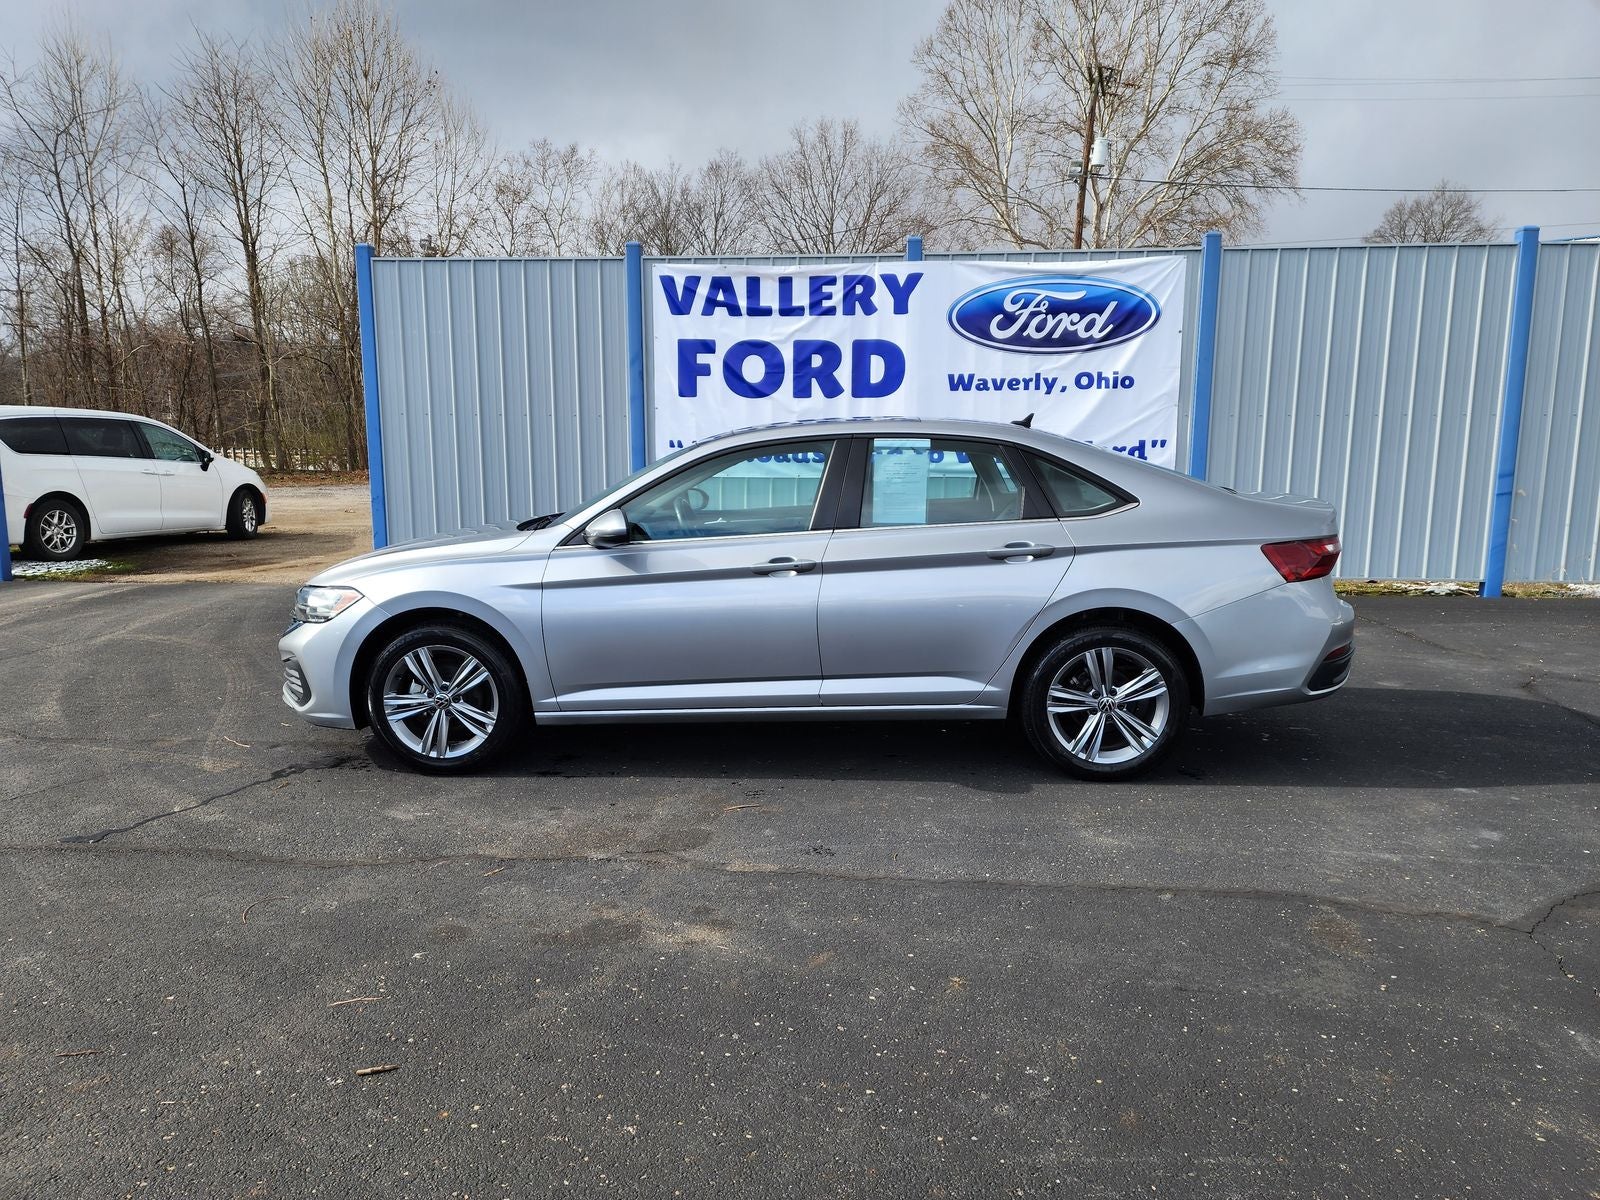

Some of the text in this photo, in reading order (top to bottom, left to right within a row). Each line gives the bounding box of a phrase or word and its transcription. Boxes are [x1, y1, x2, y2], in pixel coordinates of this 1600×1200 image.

[659, 272, 925, 317] VALLERY
[989, 288, 1118, 340] Ford
[677, 338, 906, 399] FORD
[947, 371, 1135, 395] Waverly, Ohio
